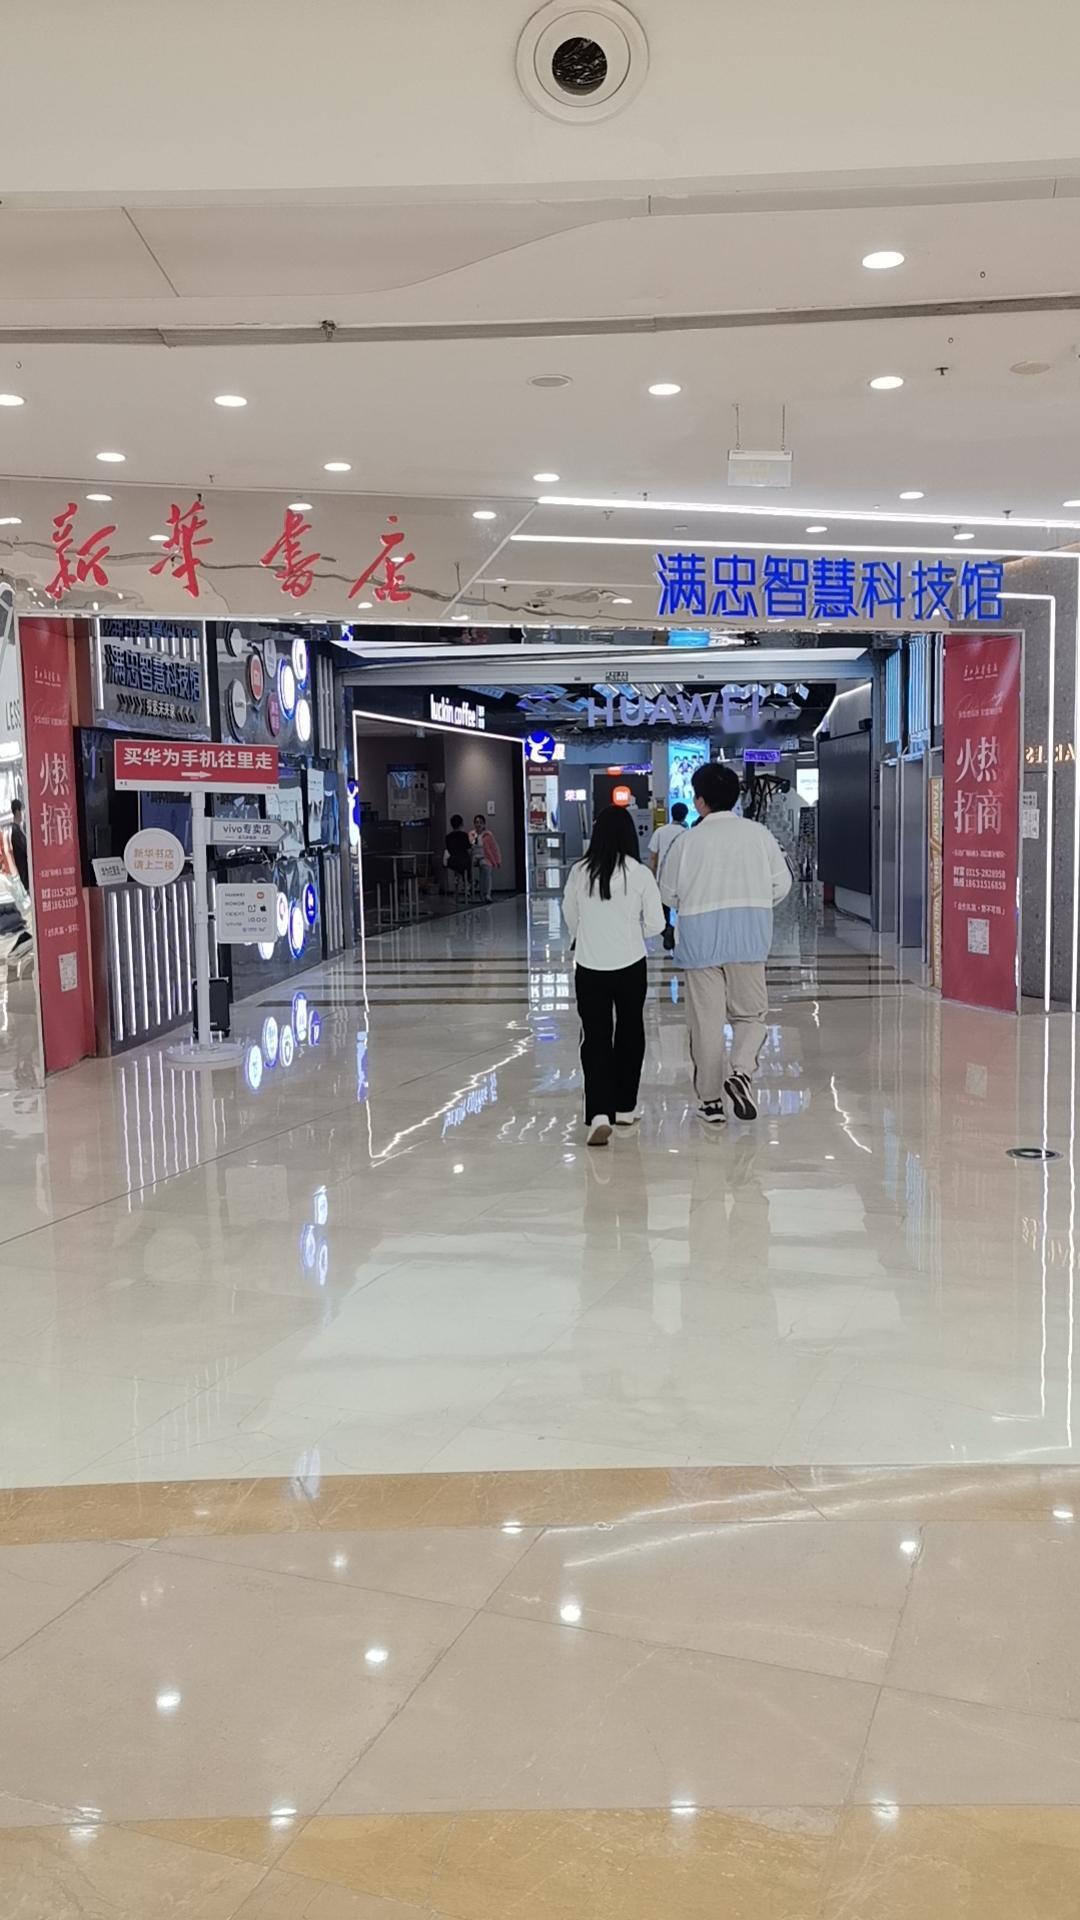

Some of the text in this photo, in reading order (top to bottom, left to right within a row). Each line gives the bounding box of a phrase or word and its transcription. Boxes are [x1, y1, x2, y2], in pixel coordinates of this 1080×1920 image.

[656, 552, 1004, 620] 满忠智慧科技馆
[430, 693, 453, 723] luckin
[454, 701, 476, 728] coffee
[588, 691, 760, 732] HUAWEI
[123, 747, 273, 771] 买华为手机往里走
